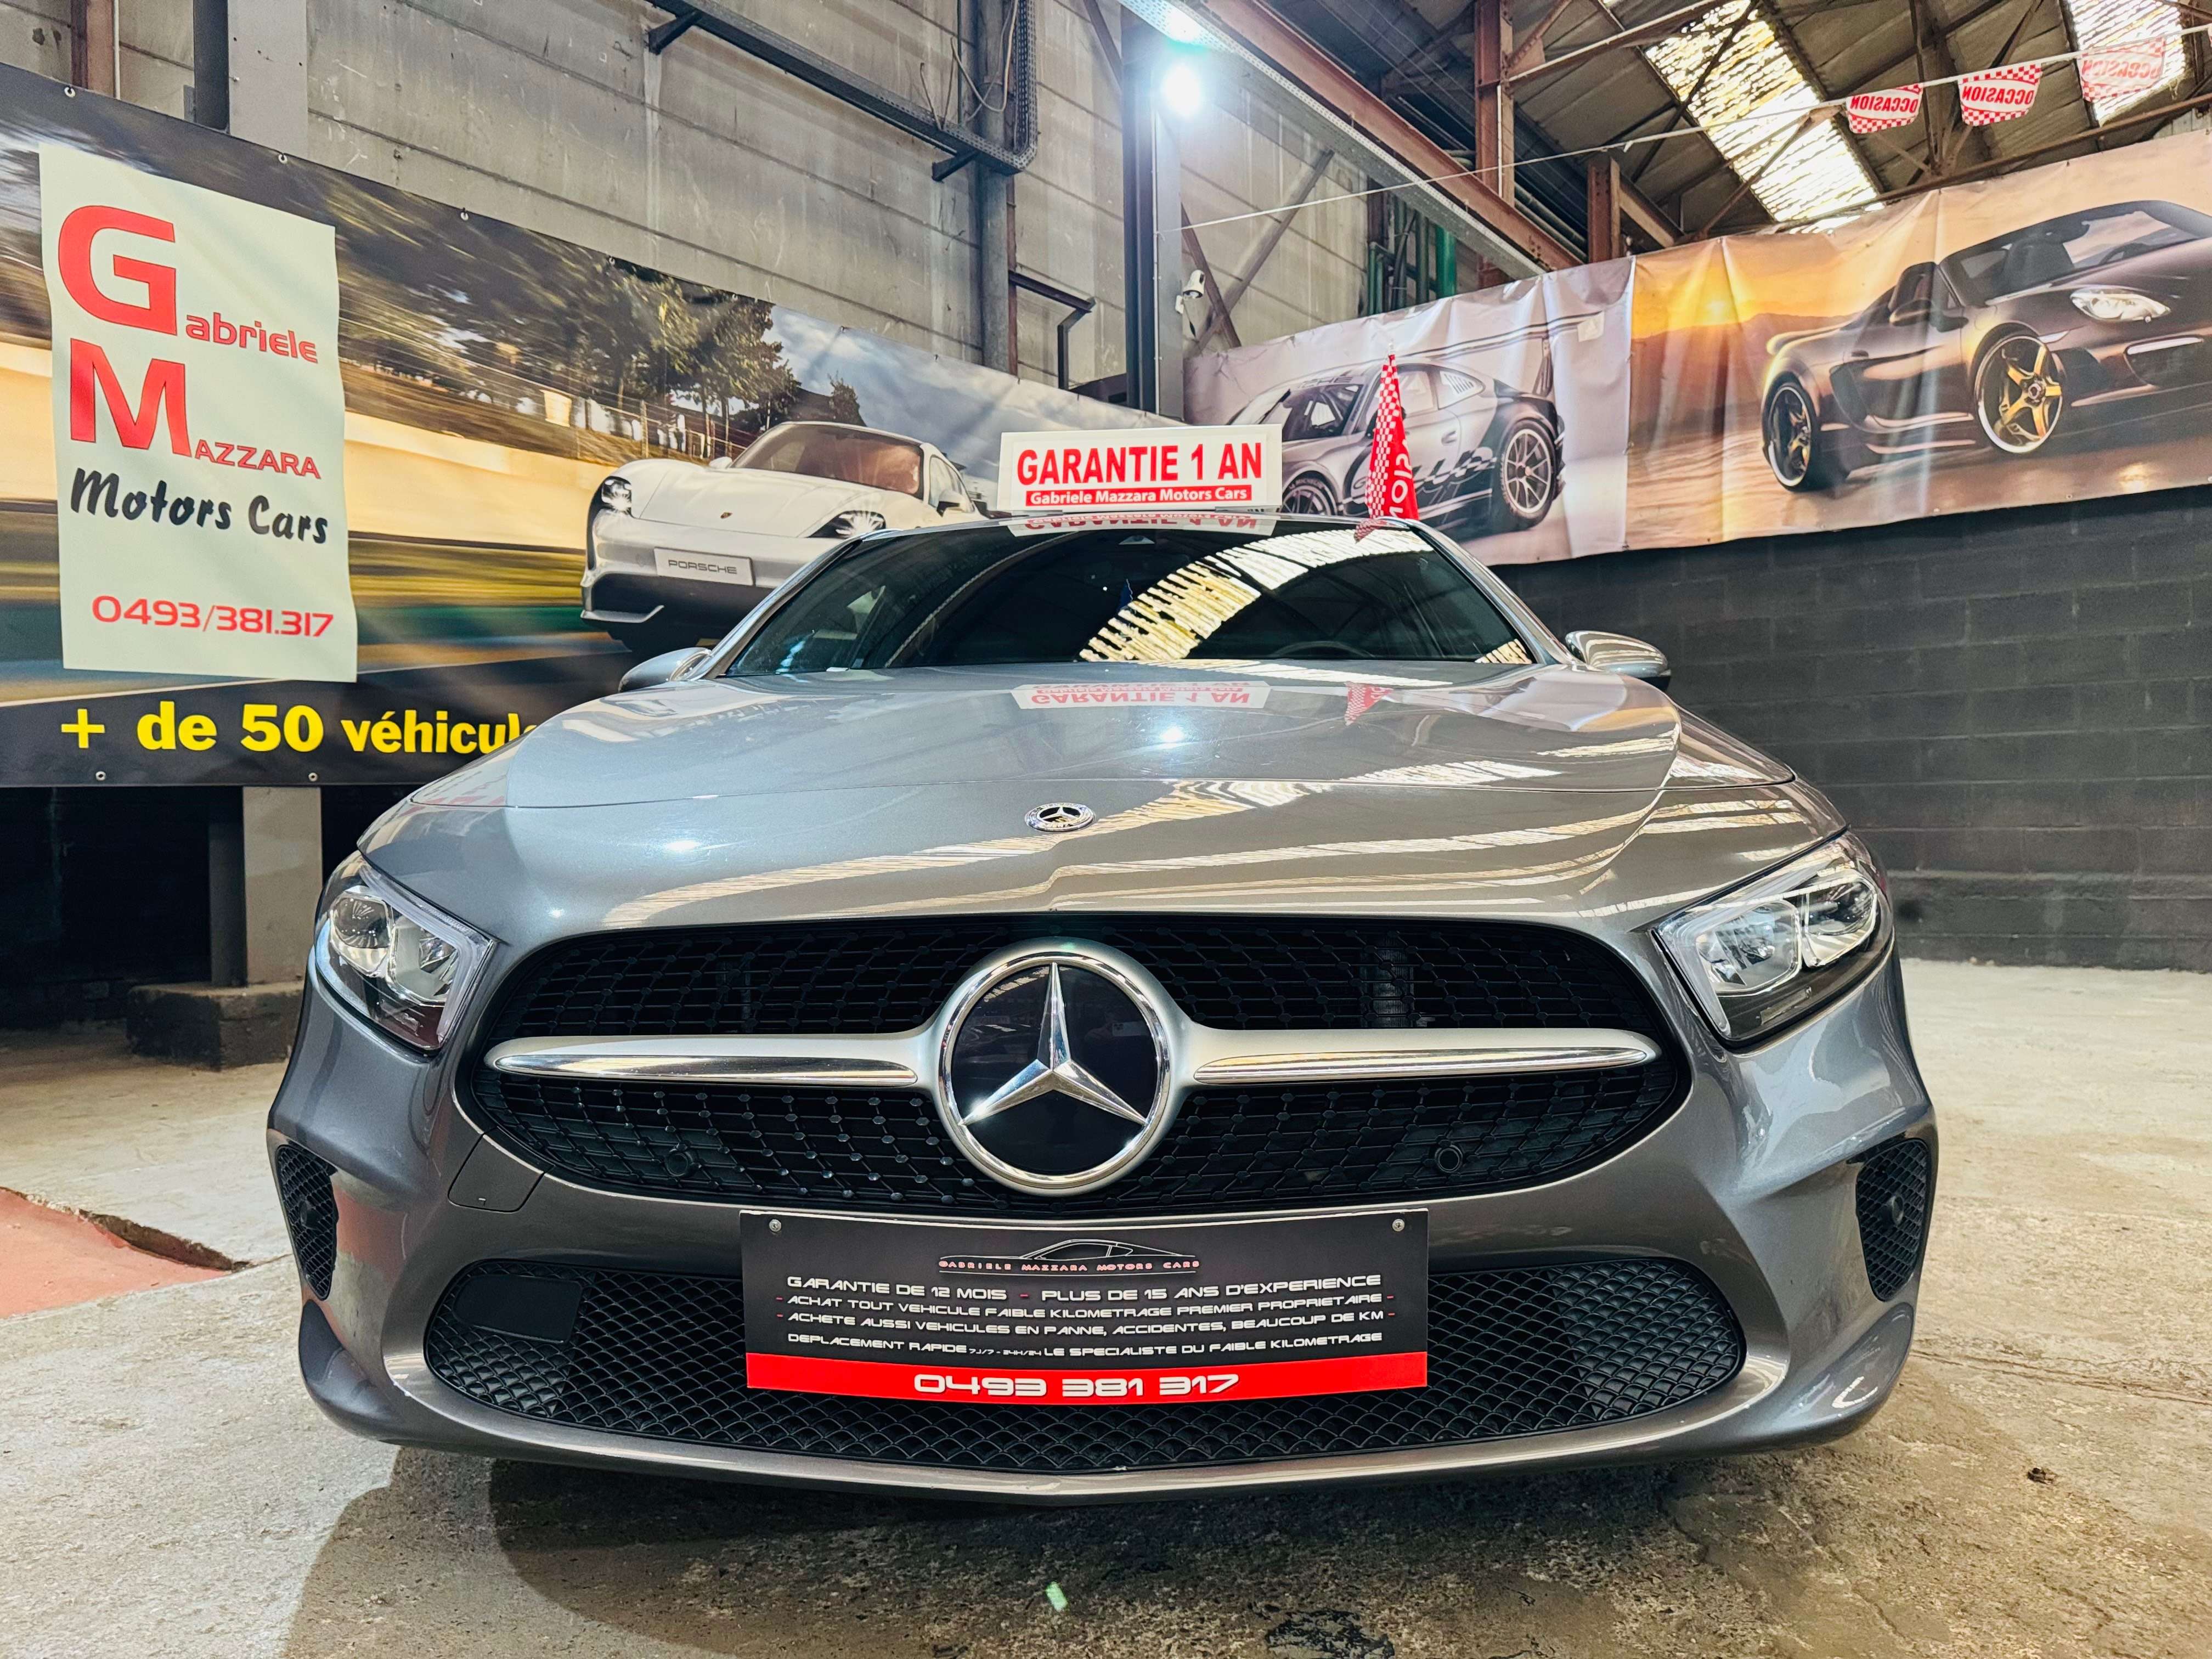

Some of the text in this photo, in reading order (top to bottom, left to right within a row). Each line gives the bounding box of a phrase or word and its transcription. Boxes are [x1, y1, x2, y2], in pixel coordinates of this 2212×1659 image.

[1017, 442, 1262, 486] GARANTIE 1 AN
[71, 467, 328, 544] Motors Cars
[1030, 487, 1247, 505] Gabriele Mazzara Motors Cars
[668, 558, 737, 574] PORSCHE
[92, 595, 334, 637] 0493/381.317
[137, 701, 217, 751] de
[241, 704, 324, 752] 50
[341, 710, 537, 754] véhicul
[939, 1261, 1012, 1271] GABRIELE
[1163, 1261, 1199, 1269] CARS
[787, 1276, 890, 1294] GARANTIE
[896, 1284, 925, 1297] DE
[932, 1286, 950, 1297] 12
[956, 1288, 1007, 1300] MOIS
[1041, 1290, 1101, 1301] PLUS
[1108, 1289, 1138, 1301] DE
[1144, 1288, 1167, 1300] 15
[1174, 1286, 1220, 1299] ANS
[1226, 1274, 1381, 1296] D'EXPERIENCE
[787, 1295, 843, 1308] ACHAT
[847, 1299, 894, 1311] TOUT
[898, 1303, 980, 1317] VEHICULE
[985, 1307, 1046, 1318] FAIBLE
[1050, 1307, 1172, 1318] KILOMETRAGE
[1177, 1302, 1253, 1316] PREMIER
[1257, 1293, 1382, 1311] PROPRIETAIRE
[788, 1312, 856, 1325] ACHETE
[860, 1318, 911, 1330] AUSSI
[915, 1321, 1011, 1334] VEHICULES
[1014, 1325, 1040, 1335] EN
[1044, 1326, 1107, 1336] PANNE,
[1112, 1321, 1227, 1335] ACCIDENTES,
[1231, 1314, 1326, 1330] BEAUCOUP
[1331, 1312, 1355, 1323] DE
[1359, 1310, 1384, 1321] KM
[788, 1333, 905, 1350] DEPLACEMENT
[909, 1342, 967, 1353] RAPIDE
[1044, 1347, 1065, 1356] LE
[1069, 1346, 1177, 1356] SPECIALISTE
[1181, 1344, 1205, 1354] DU
[1209, 1341, 1266, 1352] FAIBLE
[1270, 1332, 1383, 1349] KILOMETRAGE
[914, 1374, 1239, 1397] 0493 381 317
